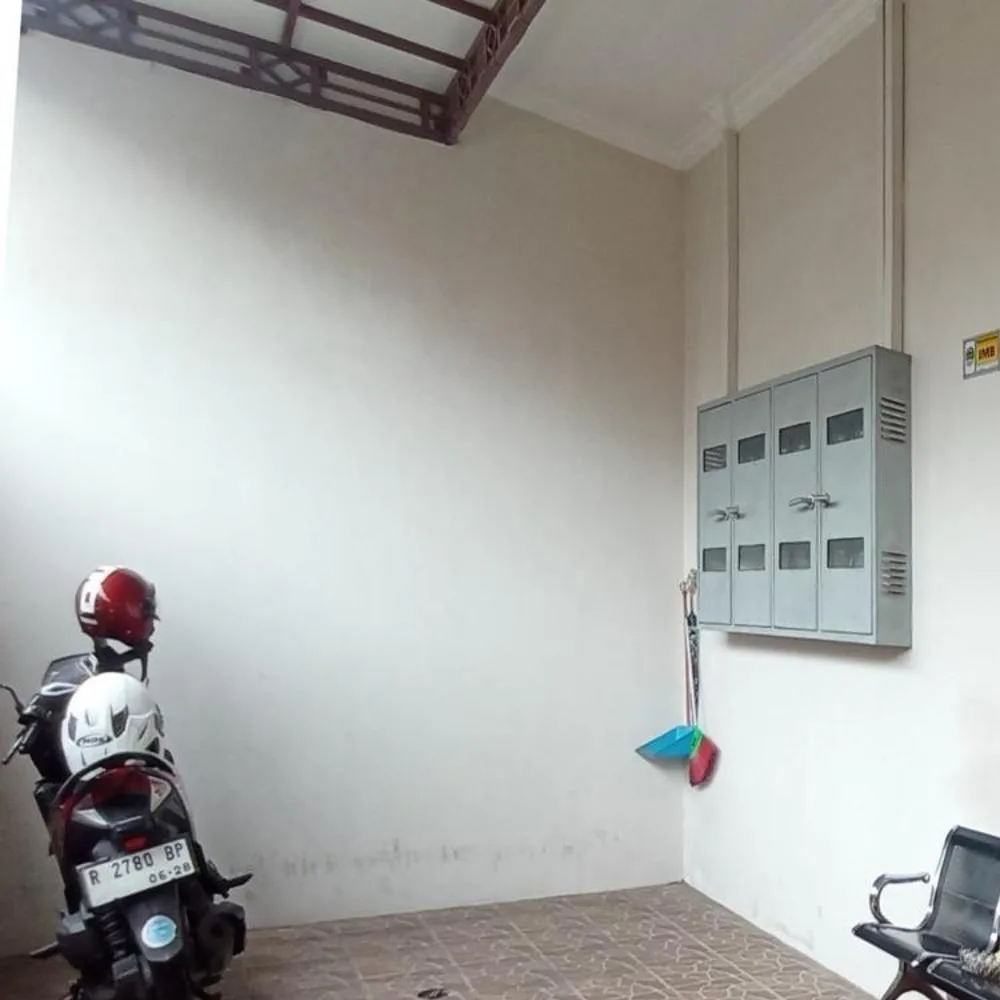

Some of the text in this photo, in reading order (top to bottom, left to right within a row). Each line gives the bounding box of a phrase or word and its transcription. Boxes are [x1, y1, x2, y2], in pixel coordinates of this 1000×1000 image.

[88, 842, 184, 886] R 2780 BP
